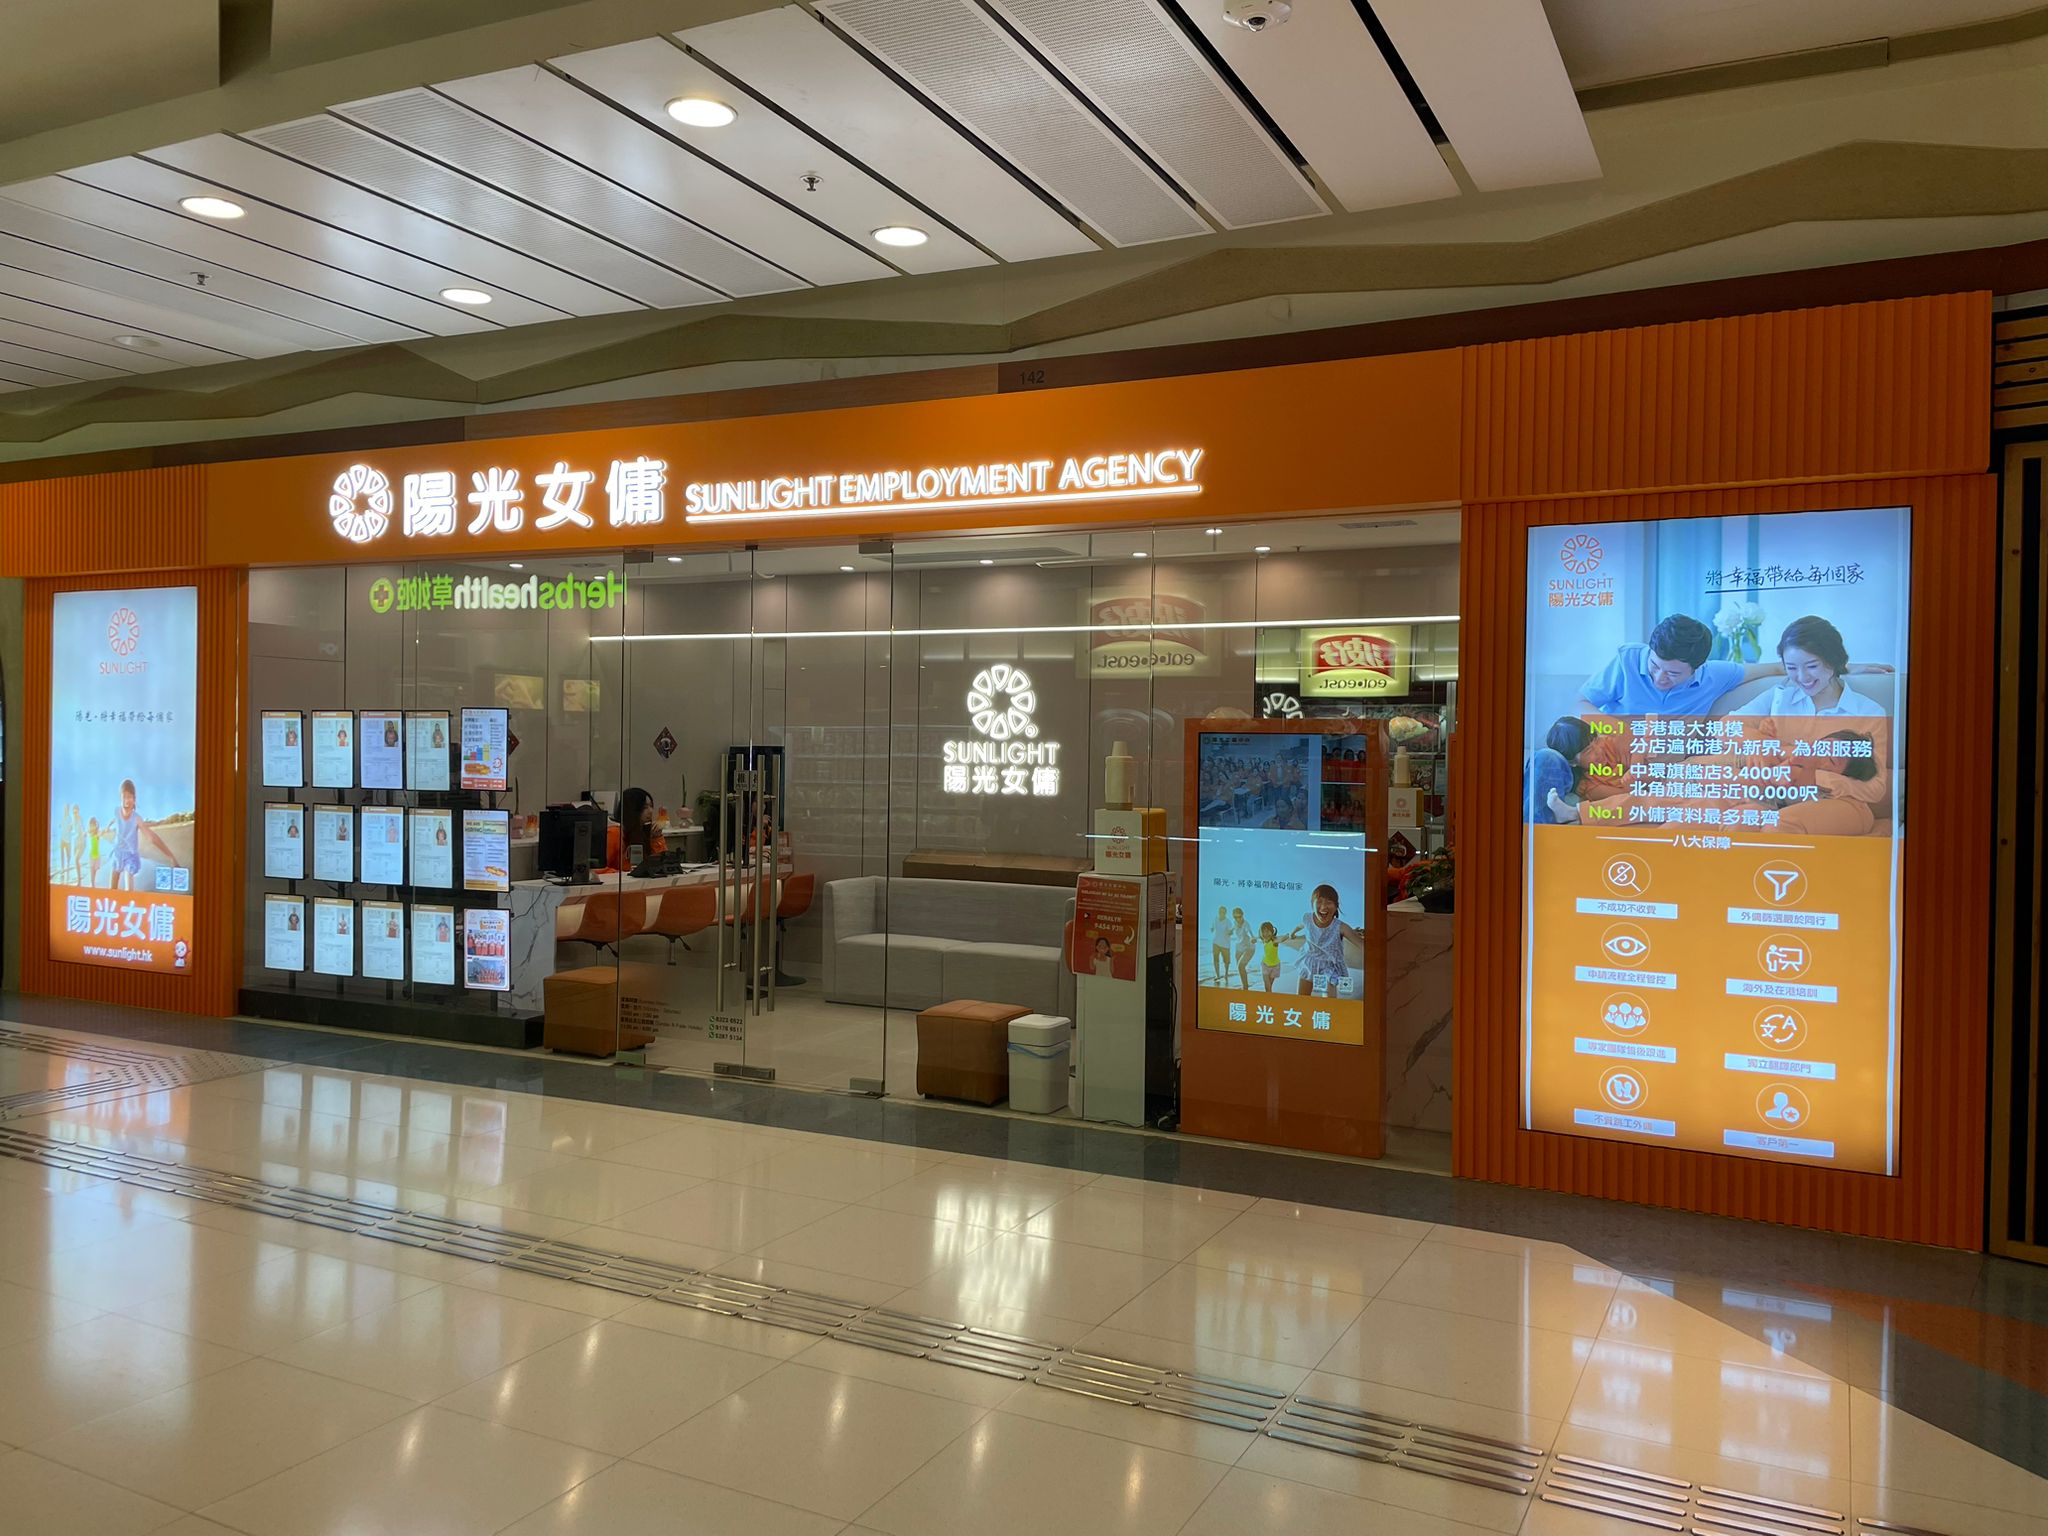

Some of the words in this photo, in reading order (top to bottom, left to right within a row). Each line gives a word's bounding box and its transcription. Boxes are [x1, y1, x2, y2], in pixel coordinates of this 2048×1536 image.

[1019, 370, 1046, 384] 142
[686, 475, 836, 513] SUNLIGHT
[840, 460, 1053, 502] EMPLOYMENT
[1059, 448, 1203, 488] AGENCY
[403, 456, 668, 537] 陽光女傭
[1548, 577, 1614, 590] SUNLIGHT
[1705, 563, 1865, 586] 將幸福帶給每個家
[1548, 591, 1614, 608] 陽光女傭
[100, 661, 148, 674] SUNLIGHT
[1590, 721, 1624, 735] No.1
[1630, 720, 1744, 738] 香港最大規模
[943, 740, 1061, 765] SUNLIGHT
[943, 765, 1060, 796] 陽光女傭
[1589, 763, 1624, 777] No.1
[1629, 781, 1818, 802] 北角旗艦店近10,000呎
[1588, 806, 1623, 820] No.1
[1629, 805, 1779, 827] 外傭資料最多最齊
[1673, 834, 1731, 850] 八大保障
[67, 895, 175, 942] 陽光女傭
[83, 945, 153, 962] www.sunlight.hk
[1229, 1002, 1332, 1030] 陽光女傭
